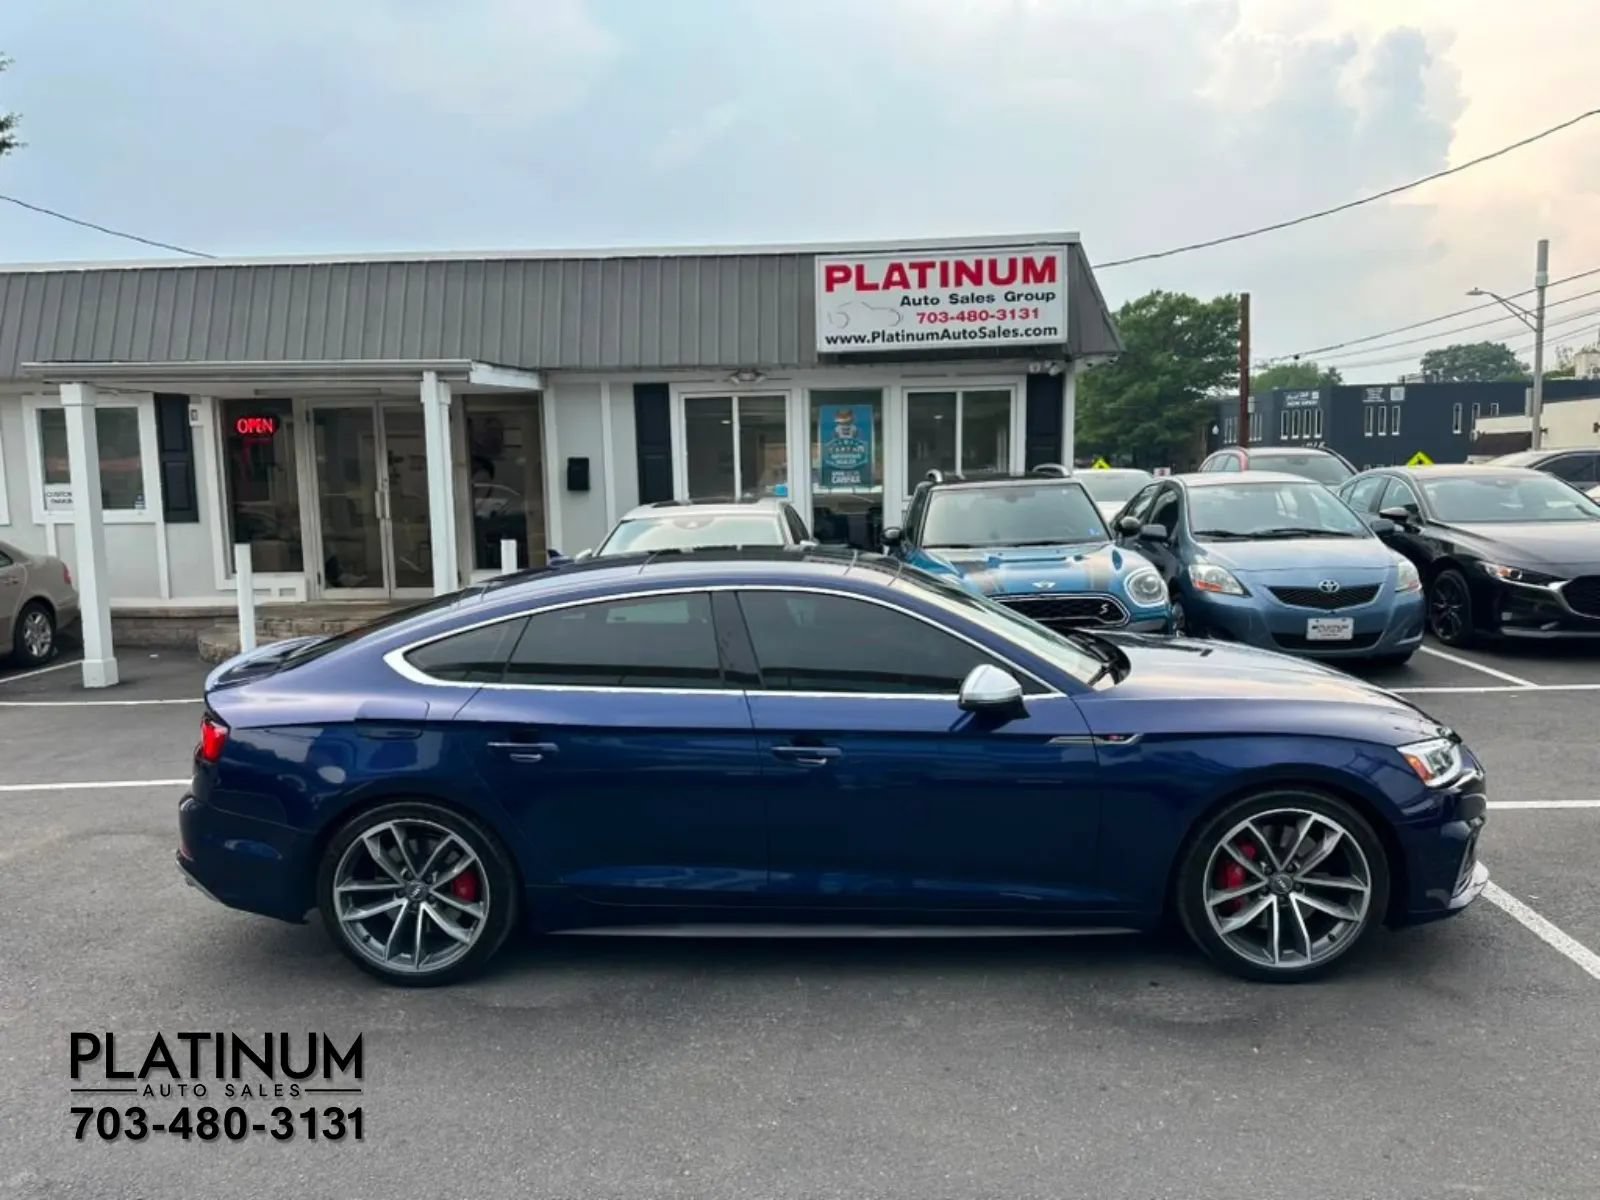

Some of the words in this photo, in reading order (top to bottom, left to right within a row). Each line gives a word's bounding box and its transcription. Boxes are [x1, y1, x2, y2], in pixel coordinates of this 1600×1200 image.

[825, 256, 1057, 293] PLATINUM
[900, 295, 940, 307] Auto
[949, 293, 996, 305] Sales
[1004, 291, 1056, 304] Group
[917, 307, 1040, 324] 703-480-3131
[825, 325, 1058, 345] www.PlatinumAutoSales.com
[237, 417, 273, 434] OPEN
